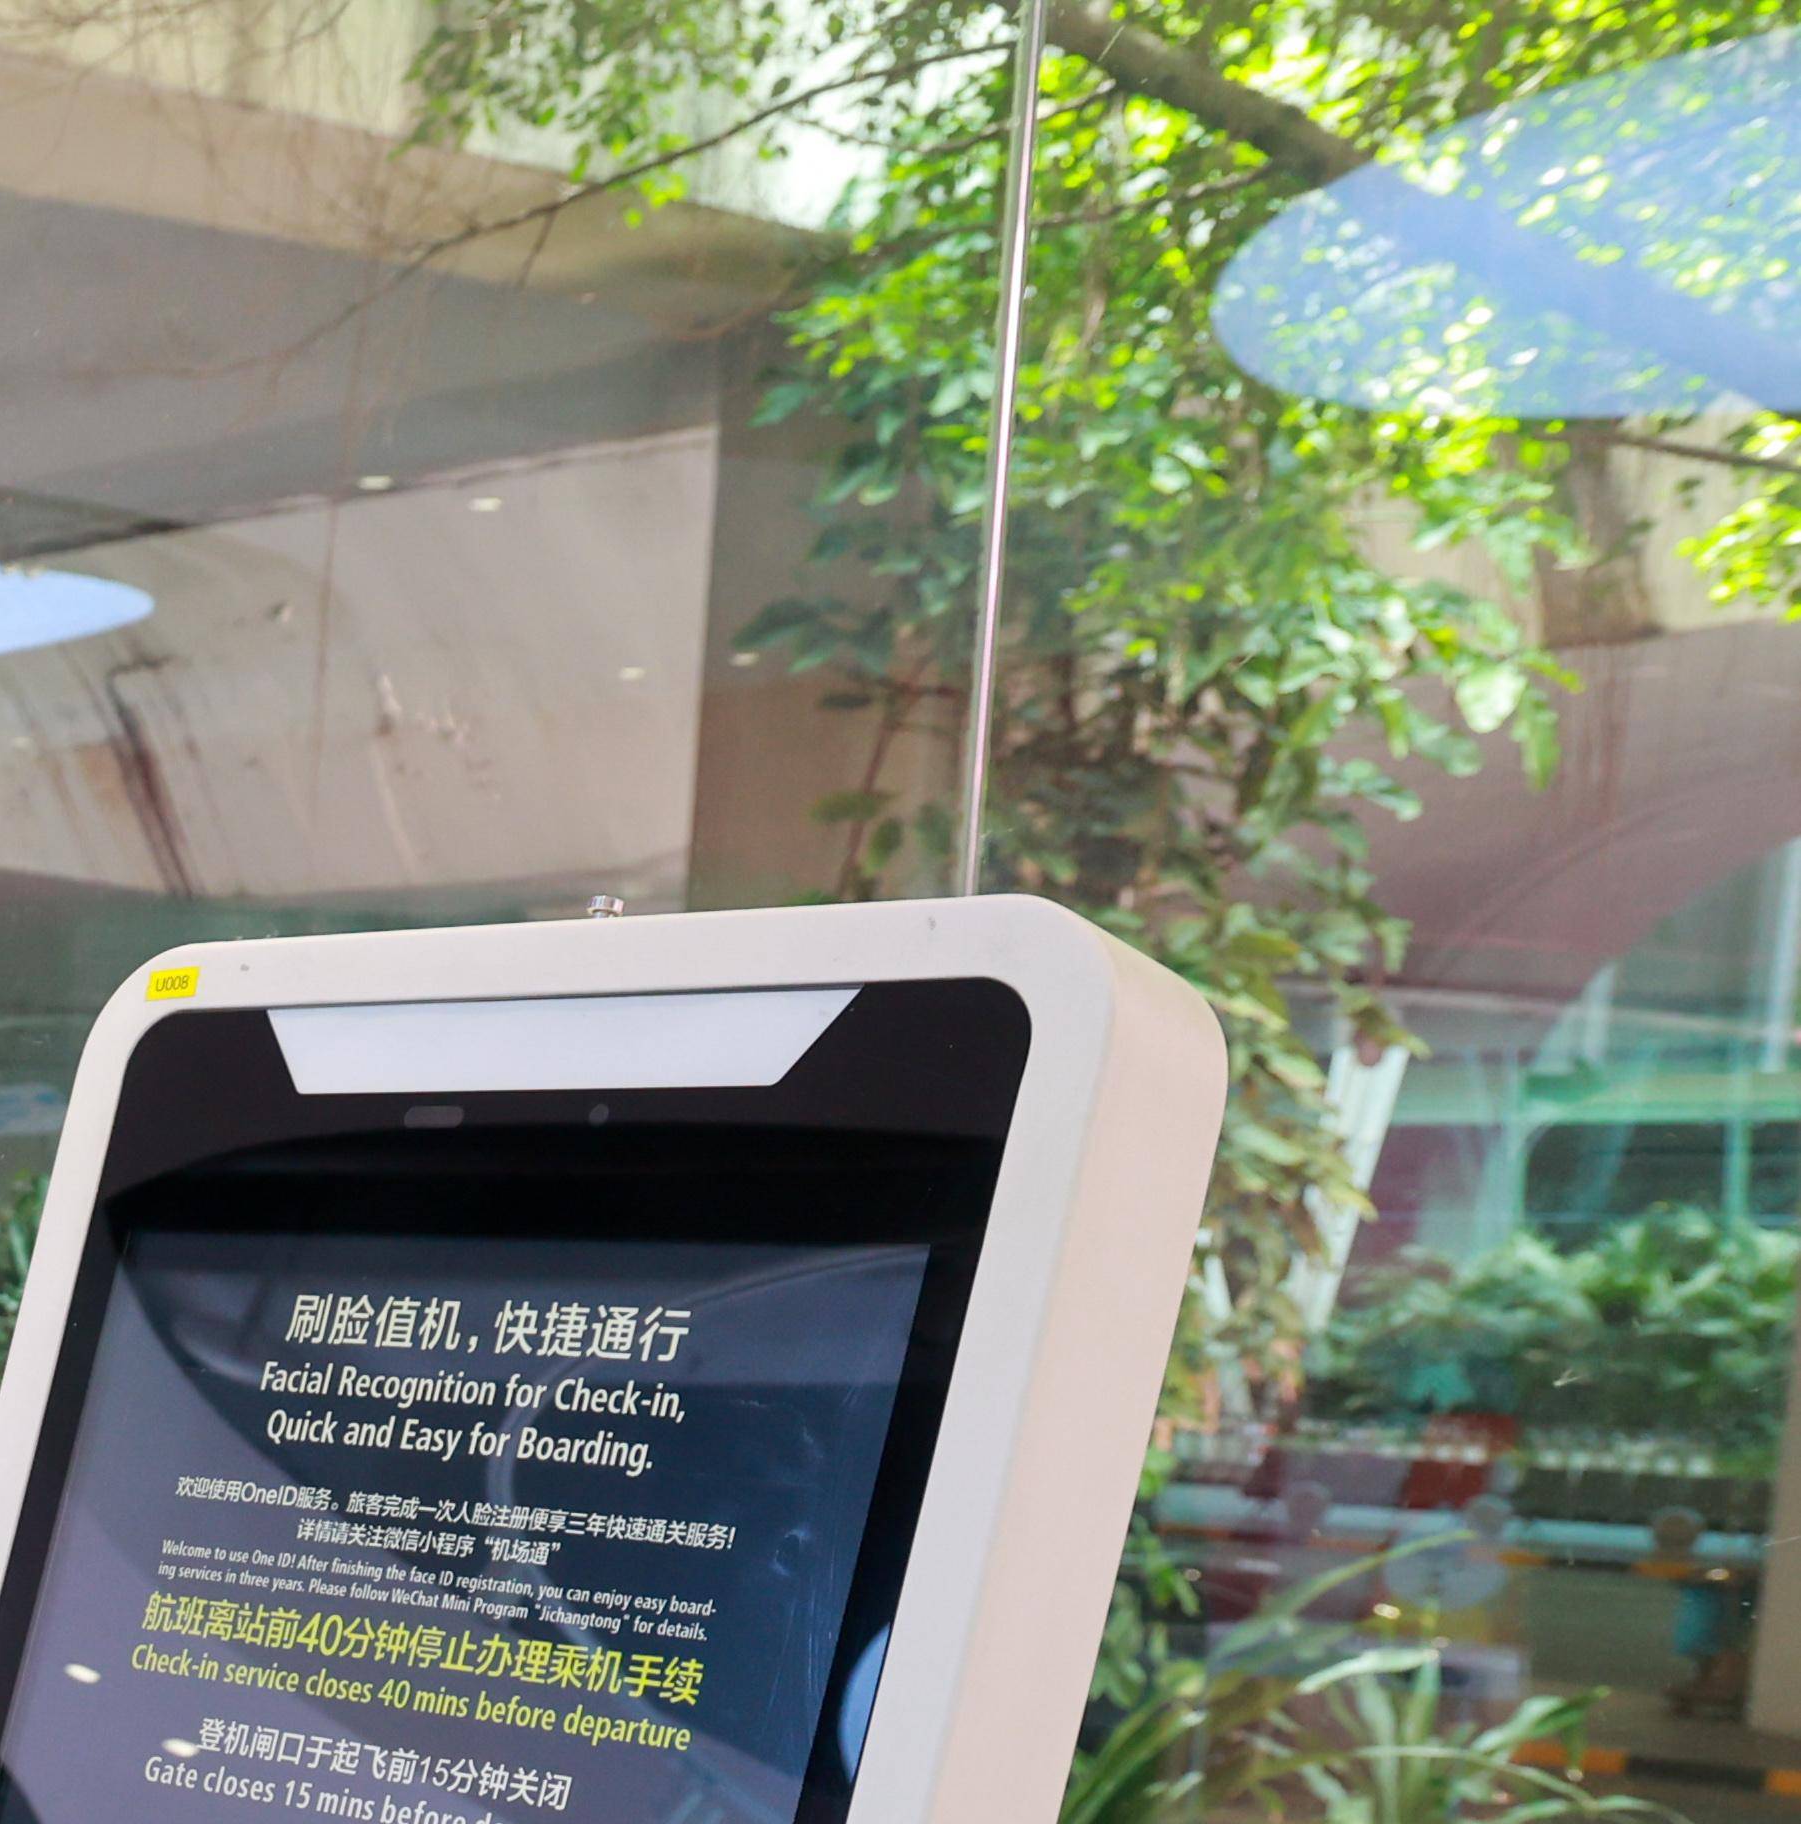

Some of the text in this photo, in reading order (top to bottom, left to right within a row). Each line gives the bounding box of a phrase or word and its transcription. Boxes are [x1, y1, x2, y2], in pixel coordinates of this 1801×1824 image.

[284, 1293, 692, 1362] 刷脸值机，快捷通行
[260, 1361, 686, 1424] Facial Recognition for Check-in,
[266, 1409, 654, 1478] Quick and Easy for Boarding.
[157, 1560, 176, 1580] ing
[177, 1565, 222, 1583] services
[224, 1569, 237, 1585] in
[239, 1570, 270, 1588] three
[271, 1576, 305, 1593] years.
[307, 1577, 347, 1598] Please
[349, 1582, 389, 1603] follow
[391, 1587, 439, 1609] WeChat
[440, 1593, 470, 1613] Mini
[472, 1596, 529, 1621] Program
[633, 1616, 655, 1634] for
[657, 1619, 709, 1643] details.
[161, 1539, 717, 1618] Welcome to use One ID! After finishing the face ID registration, you can enjoy easy board-
[142, 1590, 705, 1707] 航班离站前40分钟停止办理乘机手续
[131, 1643, 692, 1751] Check-in service closes 40 mins before departure
[144, 1755, 199, 1790] Gate
[203, 1765, 276, 1803] closes
[284, 1779, 314, 1810] 15
[316, 1789, 375, 1823] mins
[197, 1717, 573, 1811] 登机闸口于起飞前15分钟关闭
